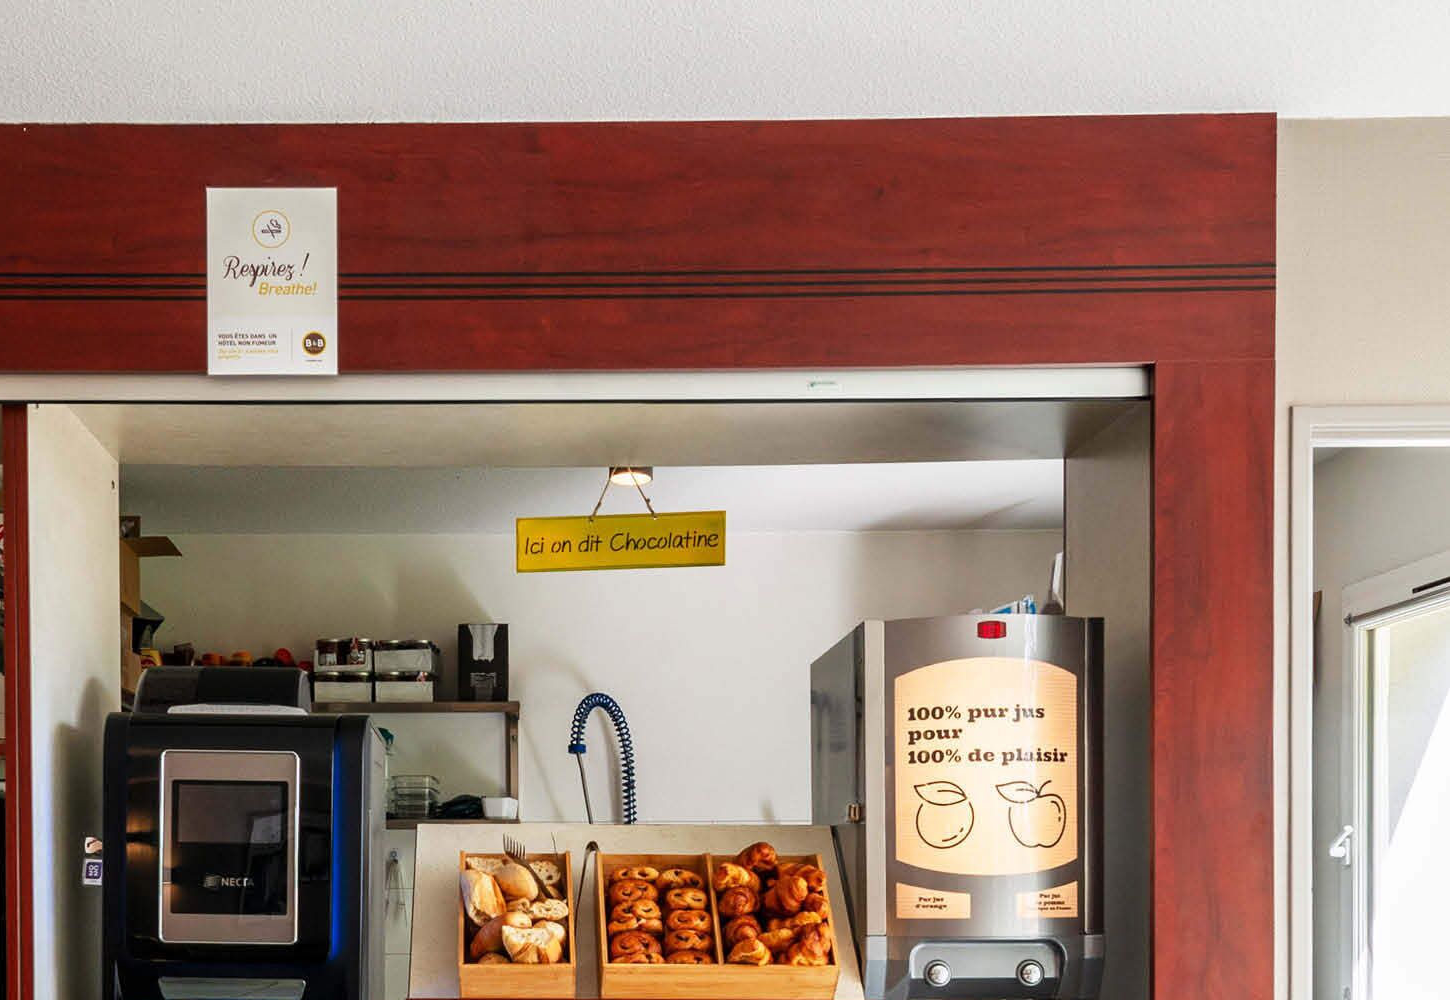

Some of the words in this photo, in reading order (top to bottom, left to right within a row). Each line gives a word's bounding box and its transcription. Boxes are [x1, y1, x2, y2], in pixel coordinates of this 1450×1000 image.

[222, 254, 295, 288] Respirez
[258, 281, 318, 296] Breathe!
[525, 537, 544, 555] Ici
[551, 539, 572, 554] on
[578, 534, 603, 553] dit
[610, 529, 720, 552] Chocolatine
[907, 705, 962, 721] 100%
[968, 706, 1009, 723] pur
[1012, 703, 1045, 723] jus
[907, 726, 963, 745] pour
[907, 749, 962, 764] 100%
[968, 748, 995, 763] de
[1002, 748, 1068, 766] plaisir
[221, 877, 255, 887] NECTA
